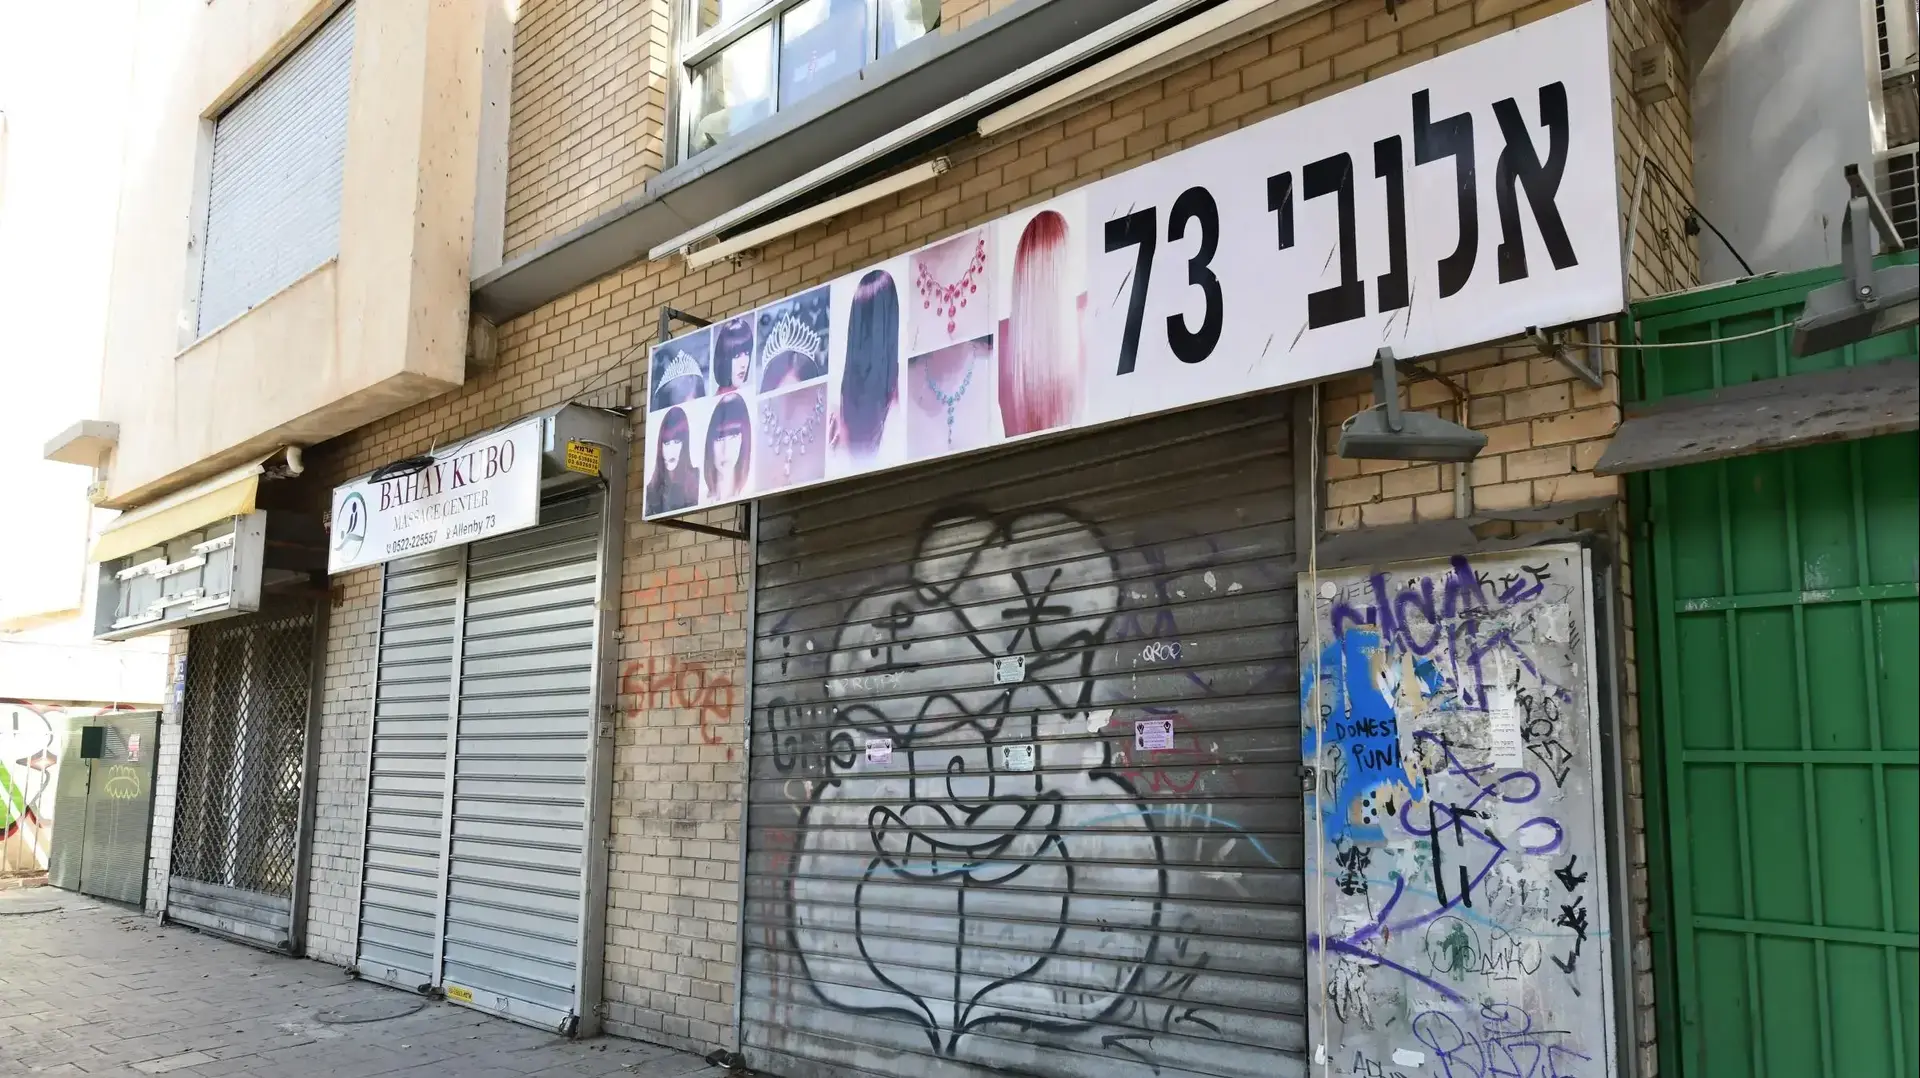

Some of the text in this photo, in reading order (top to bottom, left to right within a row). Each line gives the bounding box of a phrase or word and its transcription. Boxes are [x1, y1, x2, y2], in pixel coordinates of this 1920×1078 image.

[1104, 80, 1579, 377] אלנבי 73
[379, 439, 515, 512] BAHAY KUBO
[393, 489, 489, 531] MASSAGE CENTER
[452, 518, 484, 538] Allenby
[485, 514, 496, 529] 73
